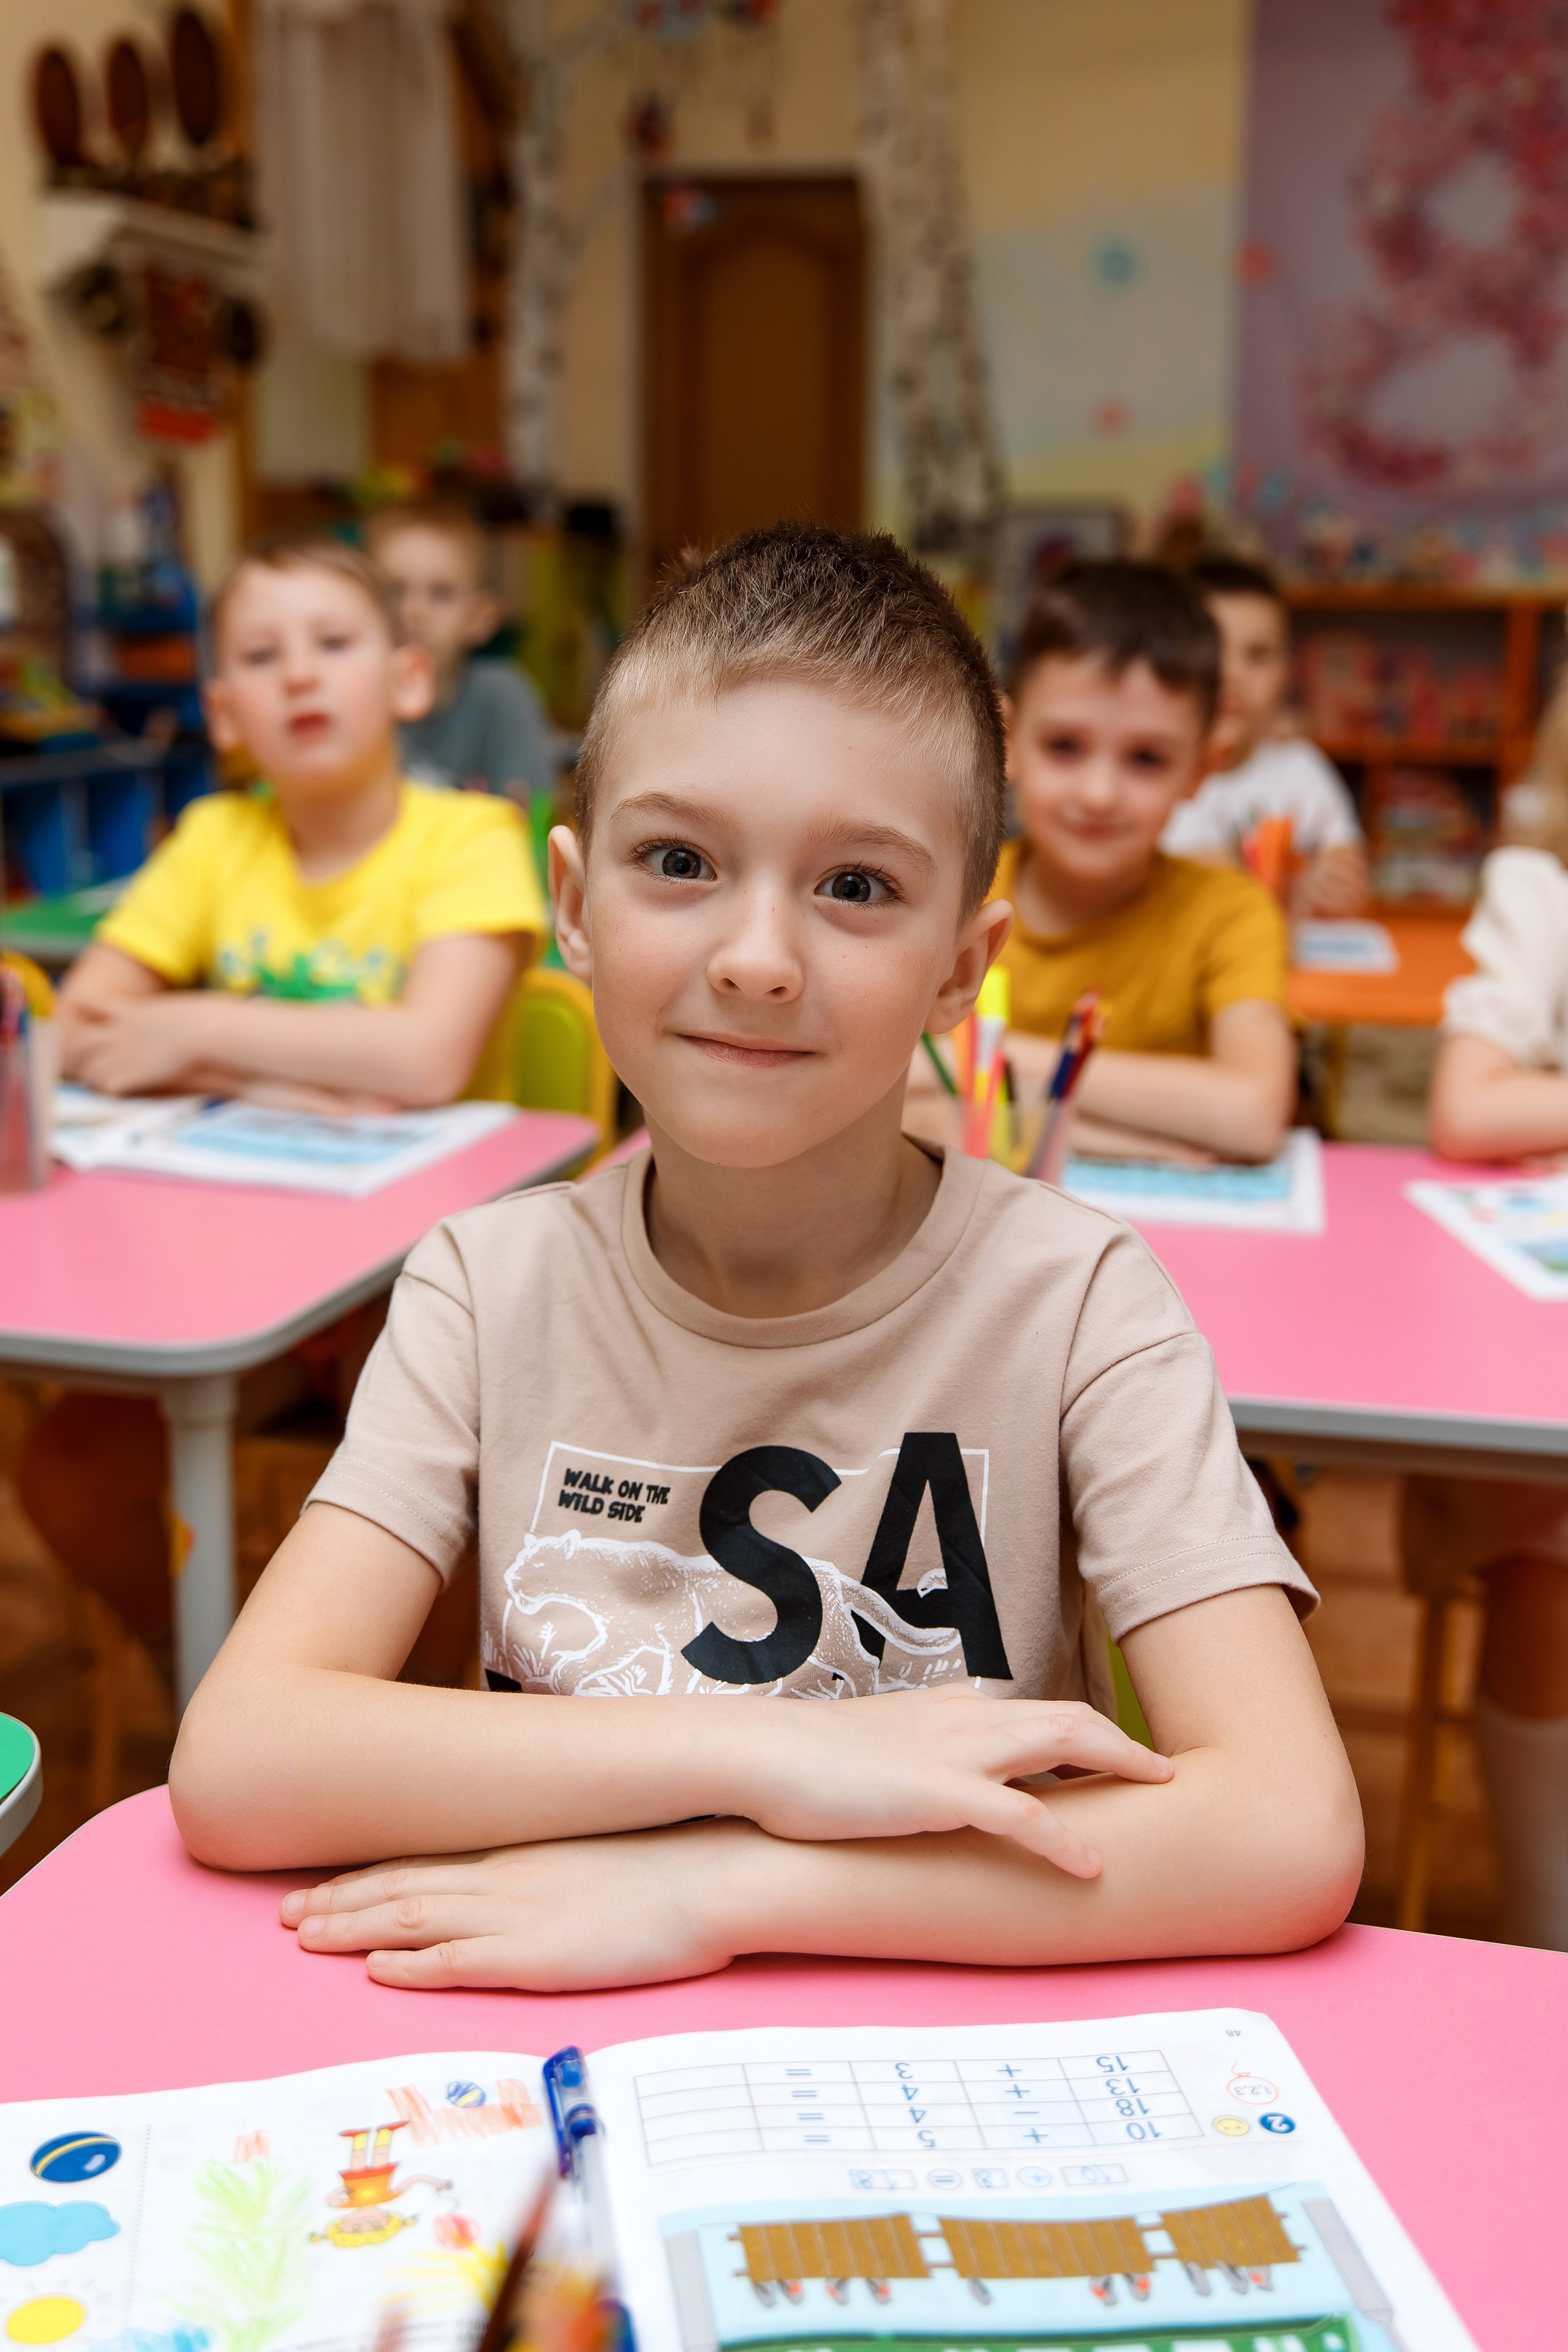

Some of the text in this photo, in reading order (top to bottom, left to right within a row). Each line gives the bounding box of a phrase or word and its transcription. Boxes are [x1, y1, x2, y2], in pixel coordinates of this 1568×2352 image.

[564, 1468, 671, 1504] WALK ON THE
[558, 1489, 646, 1523] WILD SIDE
[680, 1432, 1014, 1685] SA
[894, 2062, 914, 2079] 3
[1096, 2056, 1129, 2073] 15
[901, 2084, 919, 2101] 4
[1105, 2077, 1141, 2096] 13
[908, 2106, 927, 2124] 4
[1115, 2097, 1151, 2117] 18
[1125, 2120, 1163, 2141] 10
[1267, 2115, 1290, 2130] 2
[917, 2129, 937, 2148] 5
